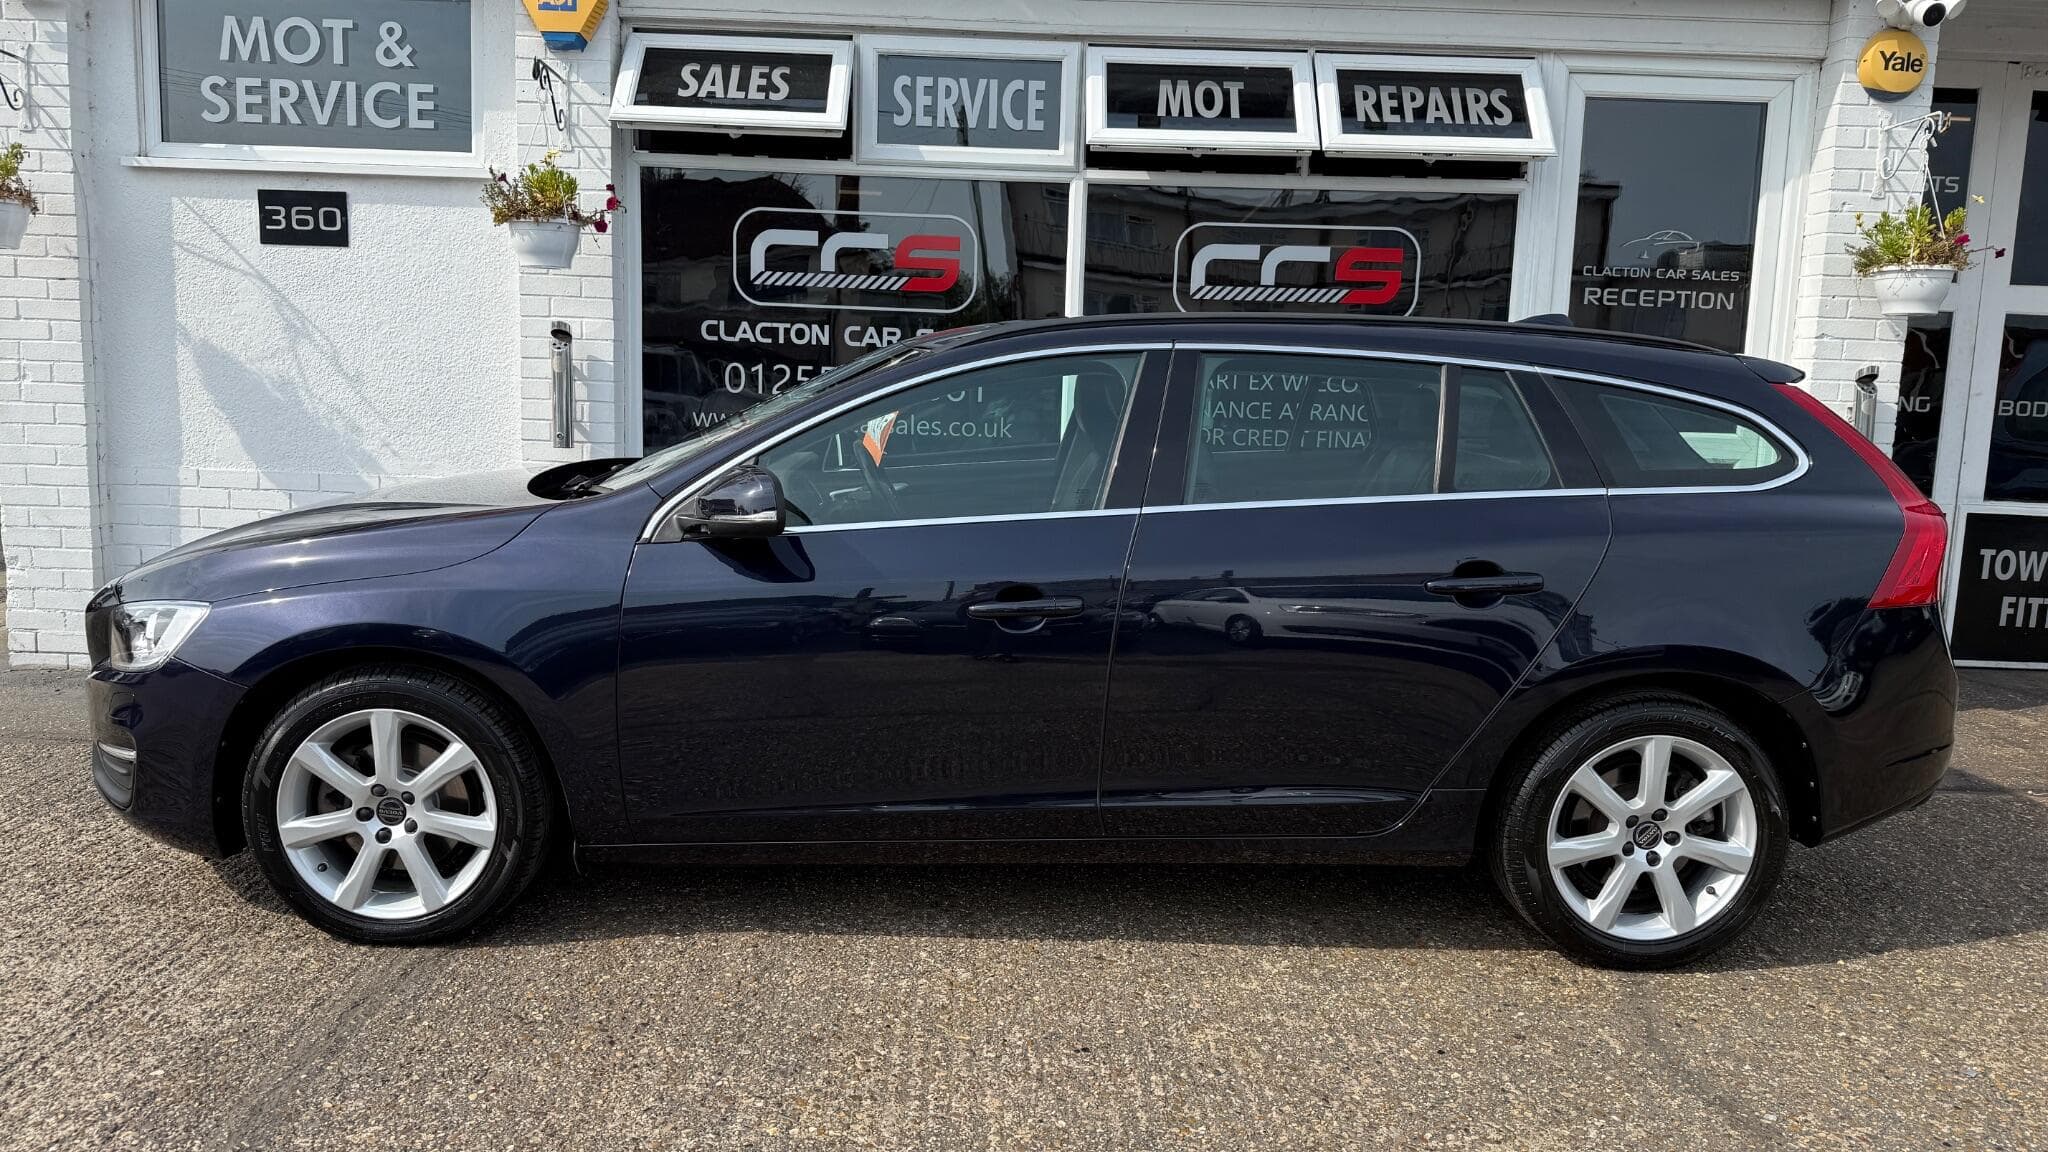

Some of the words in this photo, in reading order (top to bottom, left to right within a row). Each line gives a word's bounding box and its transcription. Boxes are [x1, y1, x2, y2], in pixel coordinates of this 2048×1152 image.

[219, 15, 354, 64] MOT
[375, 21, 415, 67] &
[1880, 51, 1924, 73] Yale
[677, 63, 791, 100] SALES
[201, 75, 435, 129] SERVICE
[893, 75, 1046, 131] SERVICE
[1156, 79, 1244, 119] MOT
[1354, 84, 1513, 126] REPAIRS
[265, 205, 342, 231] 360
[1583, 265, 1650, 279] CLACTON
[1656, 268, 1686, 280] CAR
[1692, 270, 1740, 282] SALES
[1583, 287, 1735, 310] RECEPTION
[701, 319, 830, 346] CLACTON
[844, 325, 902, 348] CAR
[1249, 374, 1274, 392] EX
[1998, 399, 2048, 418] BOD
[1980, 548, 2048, 582] TOW
